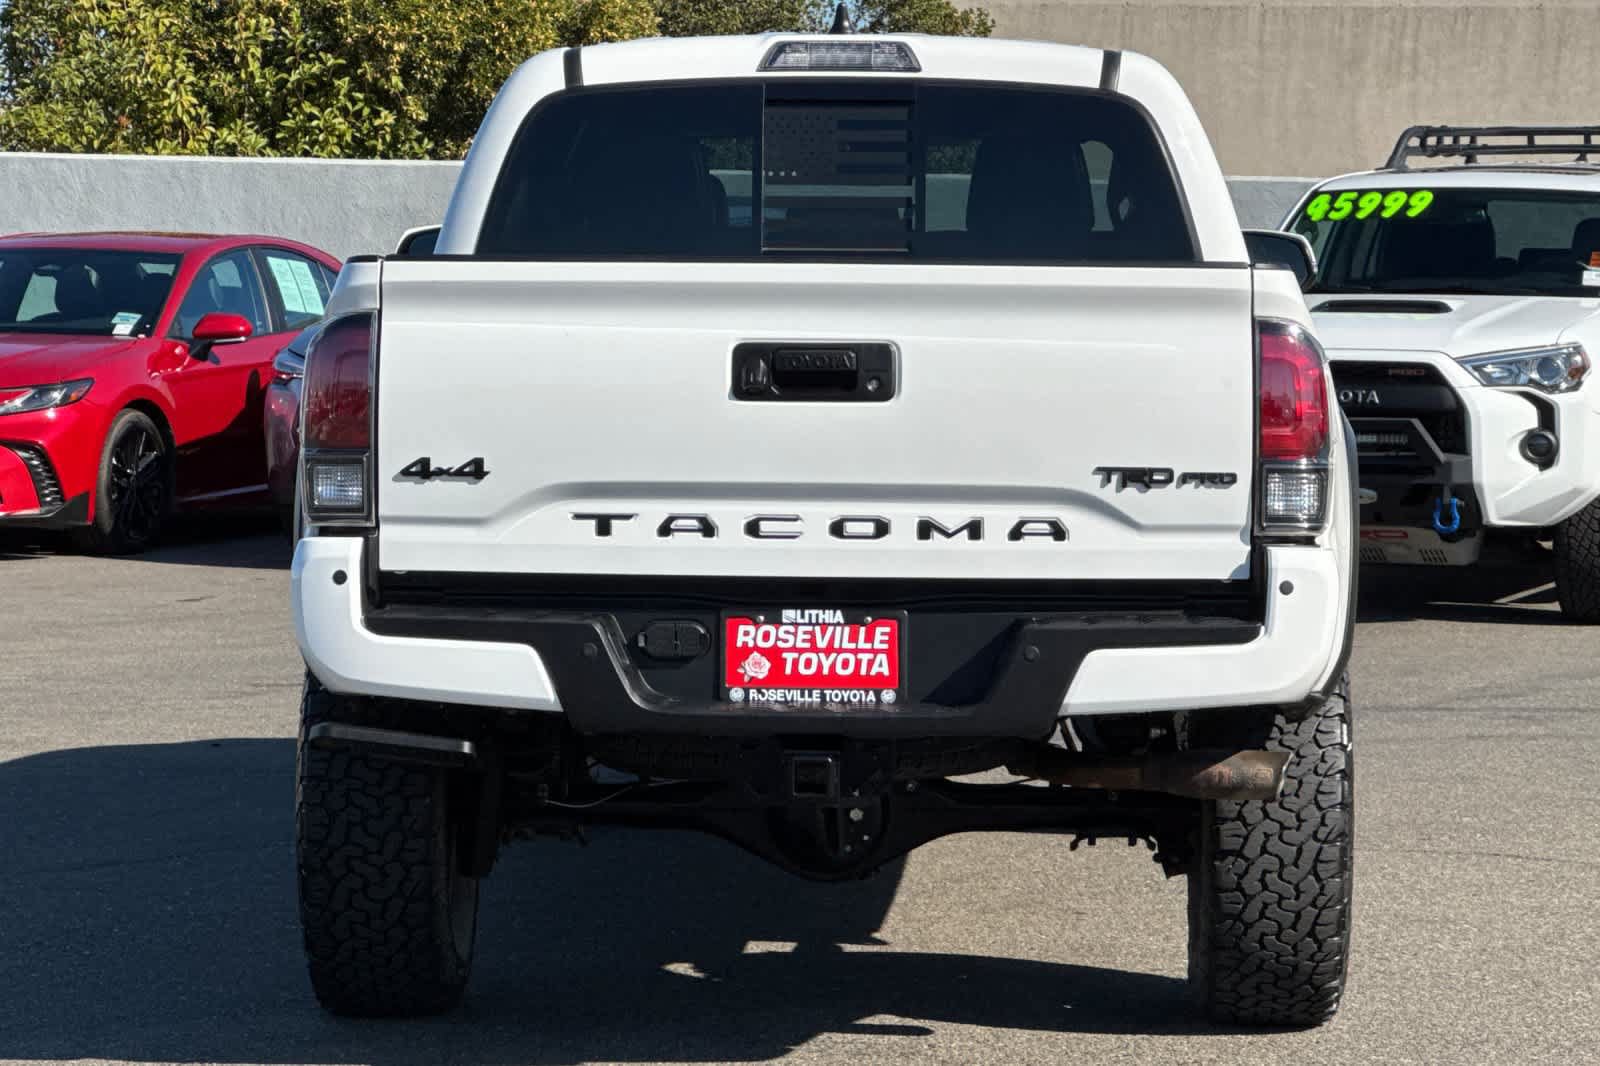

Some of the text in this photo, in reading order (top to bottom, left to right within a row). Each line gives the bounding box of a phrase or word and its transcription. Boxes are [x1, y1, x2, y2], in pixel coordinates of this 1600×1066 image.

[1307, 190, 1434, 222] 45999
[1338, 389, 1380, 405] OTA
[399, 456, 491, 479] 4x4
[1095, 466, 1238, 488] TRD PRO
[568, 512, 1070, 542] TACOMA
[795, 609, 844, 624] LITHIA
[735, 624, 891, 650] ROSEVILLE
[781, 651, 890, 677] TOYOTA
[748, 689, 876, 703] ROSEVILLE TOYOTA
